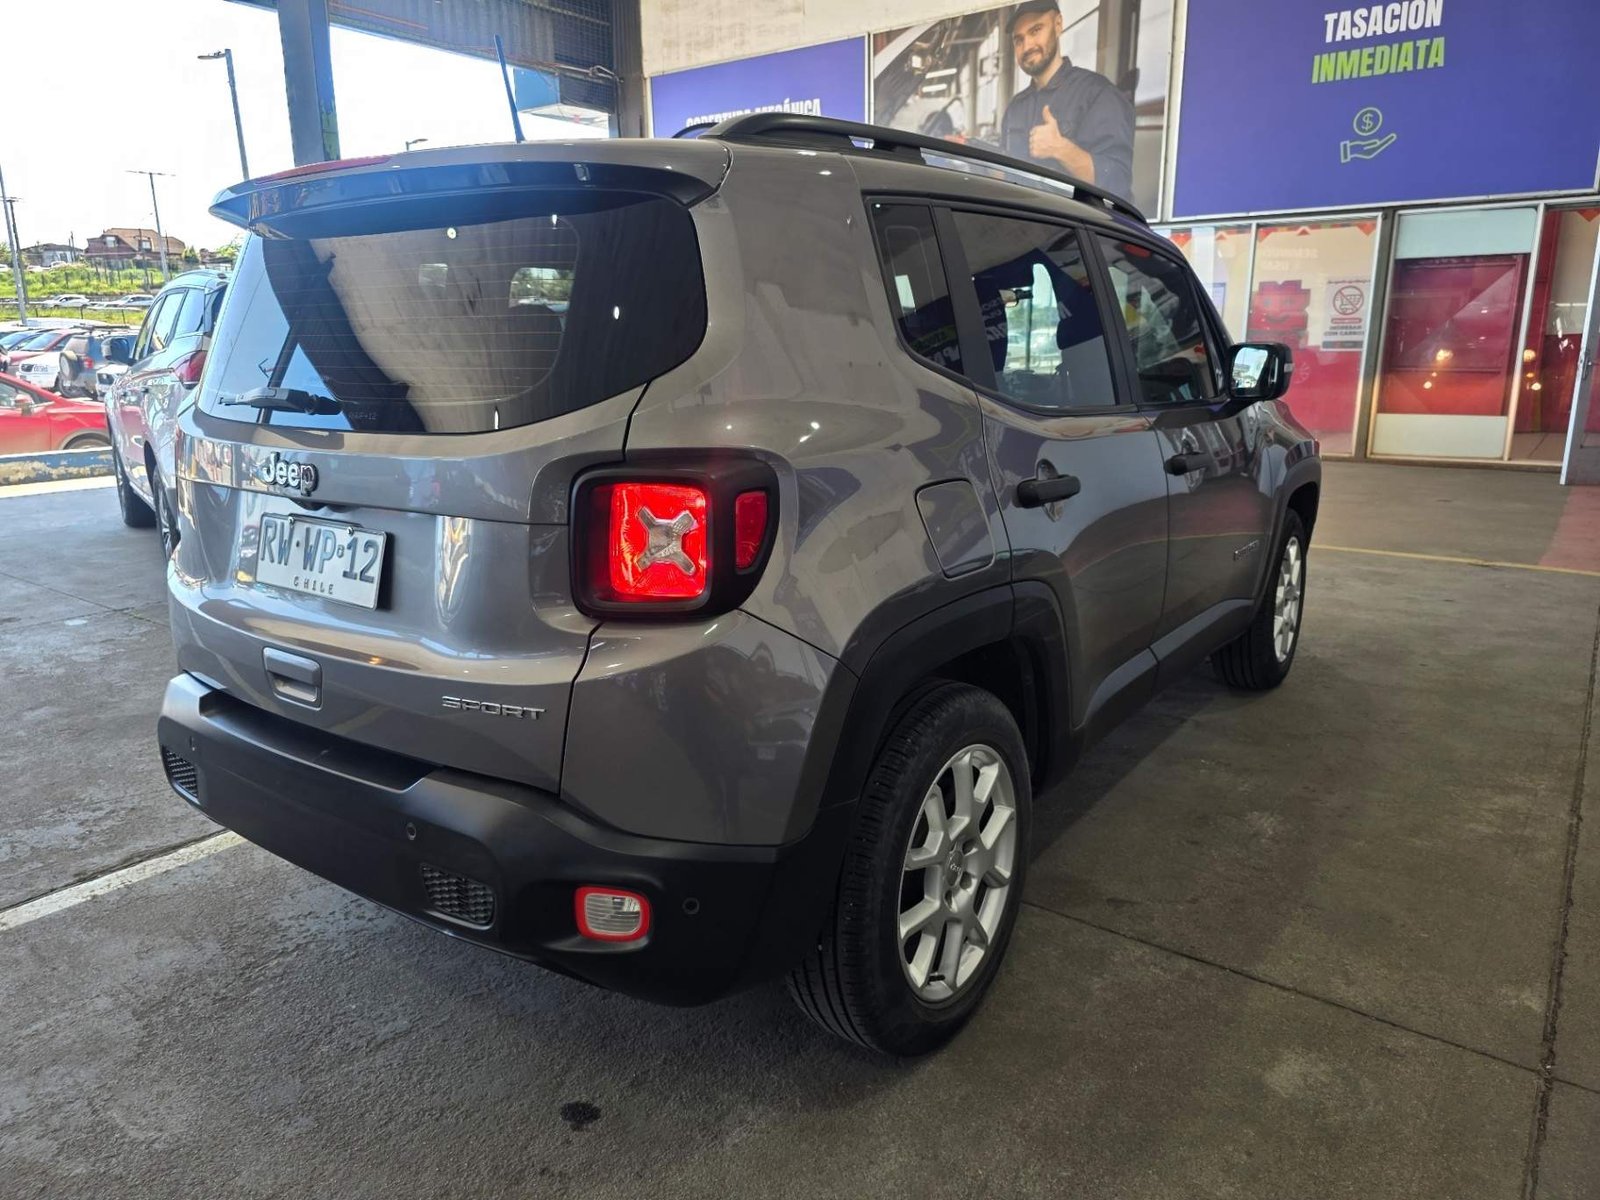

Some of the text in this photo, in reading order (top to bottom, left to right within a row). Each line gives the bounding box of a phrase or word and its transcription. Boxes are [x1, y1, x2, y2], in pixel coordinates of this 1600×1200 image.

[1312, 37, 1445, 84] INMEDIATA
[262, 452, 318, 496] Jeep
[294, 576, 334, 595] CHILE
[442, 695, 545, 719] SPORT
